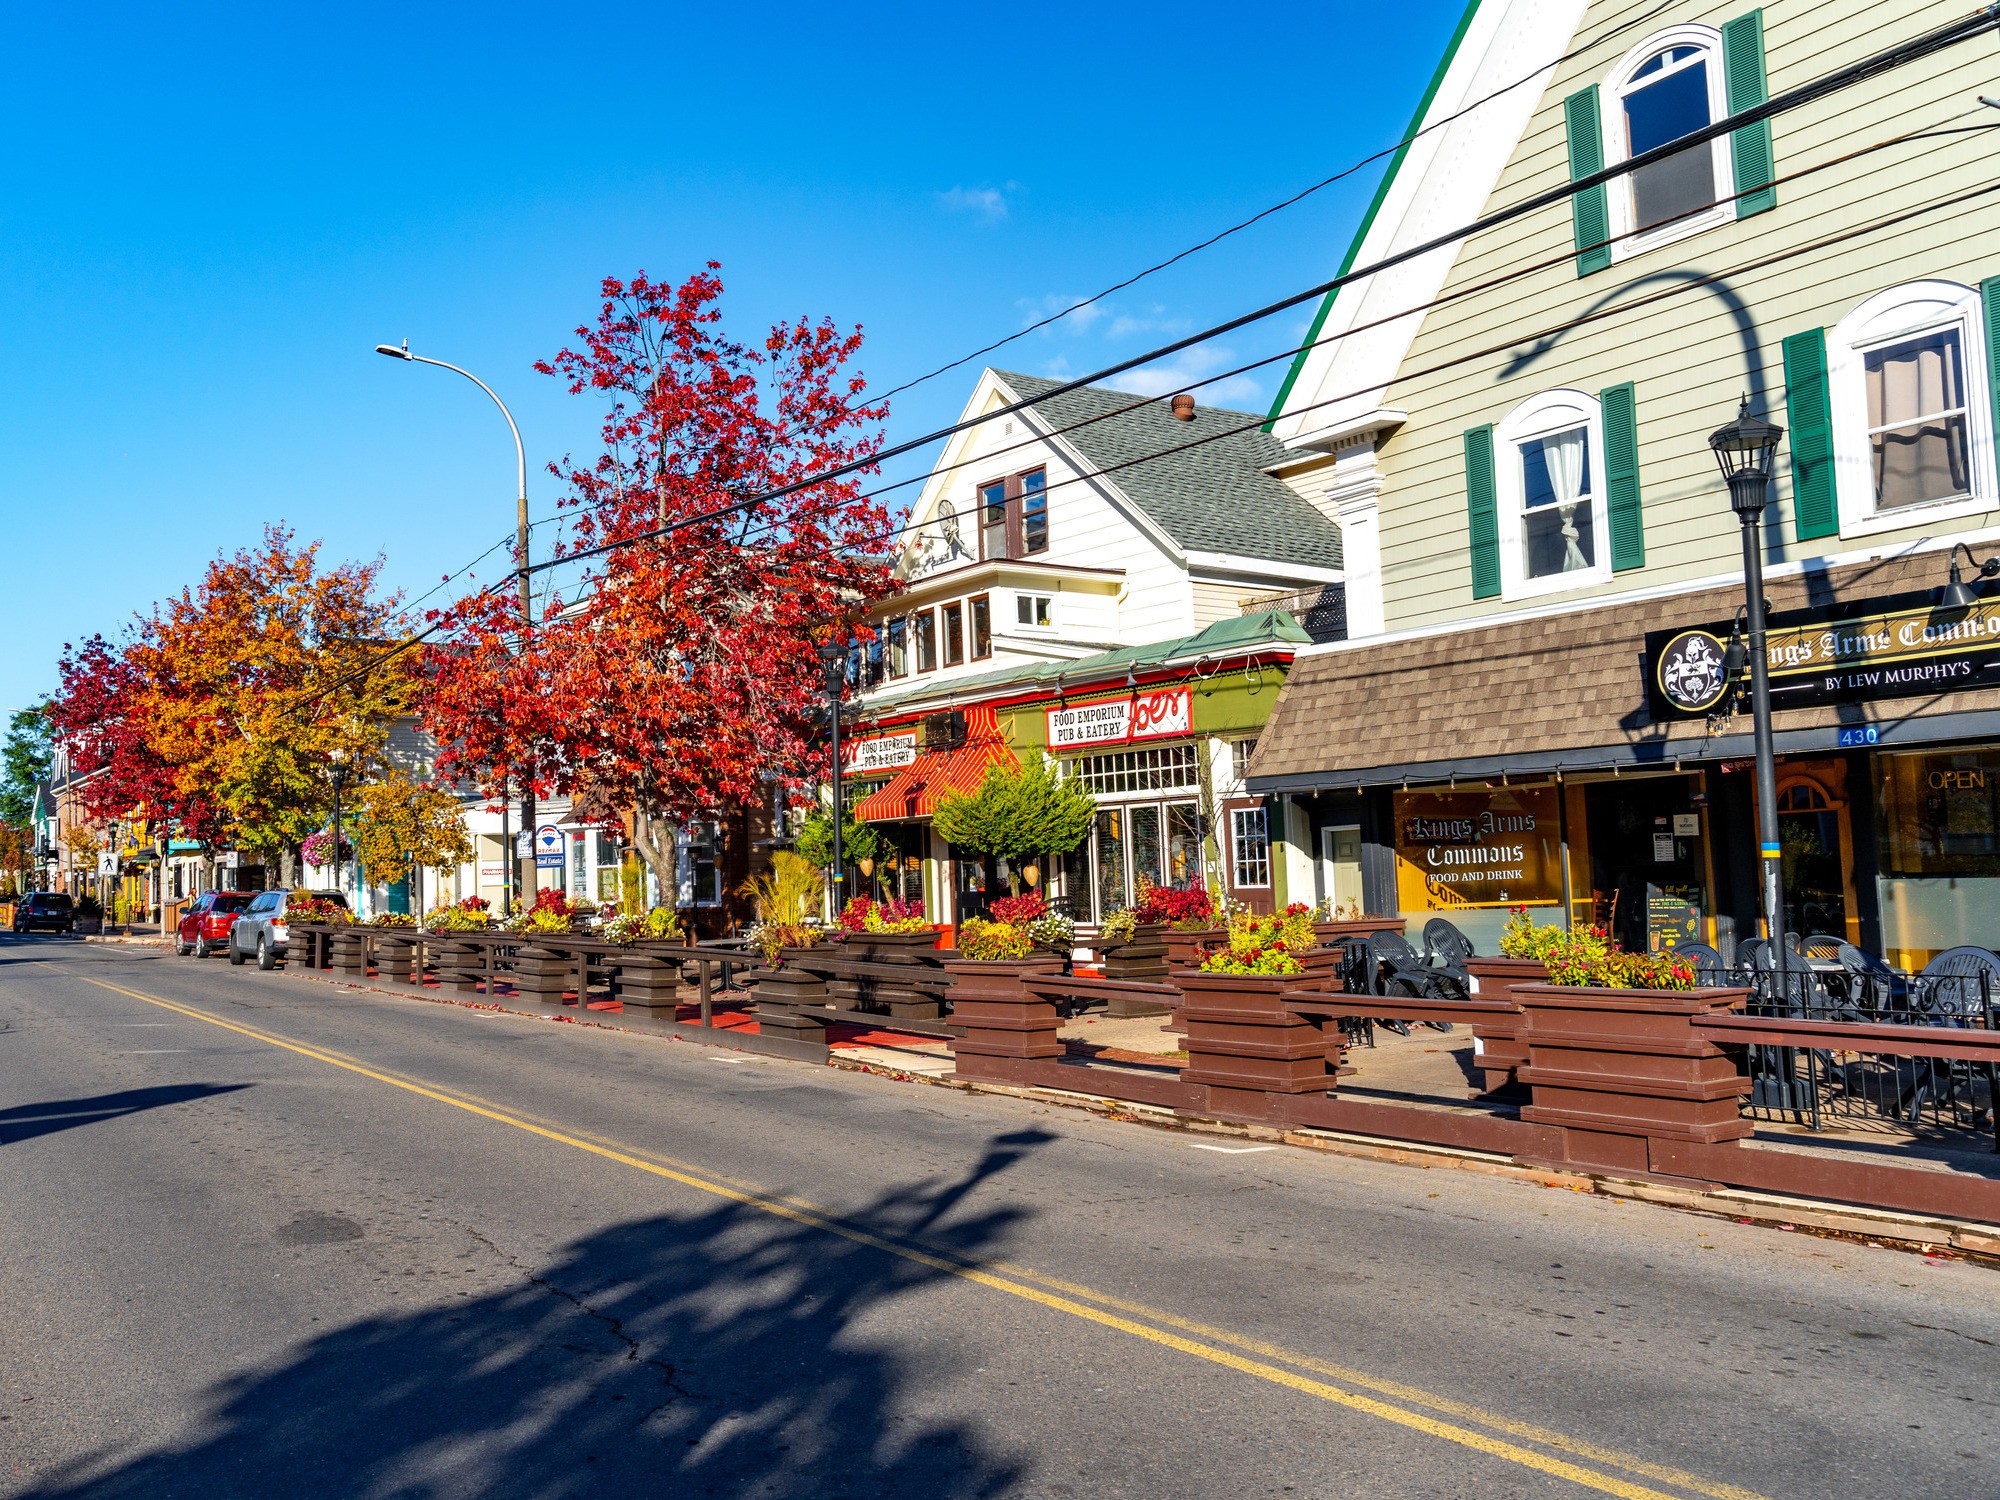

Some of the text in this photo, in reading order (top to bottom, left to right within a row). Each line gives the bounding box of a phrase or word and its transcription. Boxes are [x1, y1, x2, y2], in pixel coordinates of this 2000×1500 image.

[1820, 630, 1892, 658] Arms
[1898, 616, 2000, 647] Commo
[1825, 661, 1971, 691] BY LEW MURPHY'S
[1053, 705, 1125, 727] FOOD EMPORIUM
[1058, 722, 1121, 742] PUB & EATERY
[1842, 728, 1877, 745] 430
[862, 742, 878, 755] FOOD
[879, 737, 913, 752] EMPORIUM
[864, 755, 877, 767] PUB
[885, 751, 910, 765] EATERY
[1928, 770, 1985, 789] OPEN
[1413, 811, 1536, 840] Kings Arms
[548, 857, 563, 865] Estate
[1427, 843, 1524, 866] Commons
[1429, 870, 1523, 883] FOOD AND DRINK
